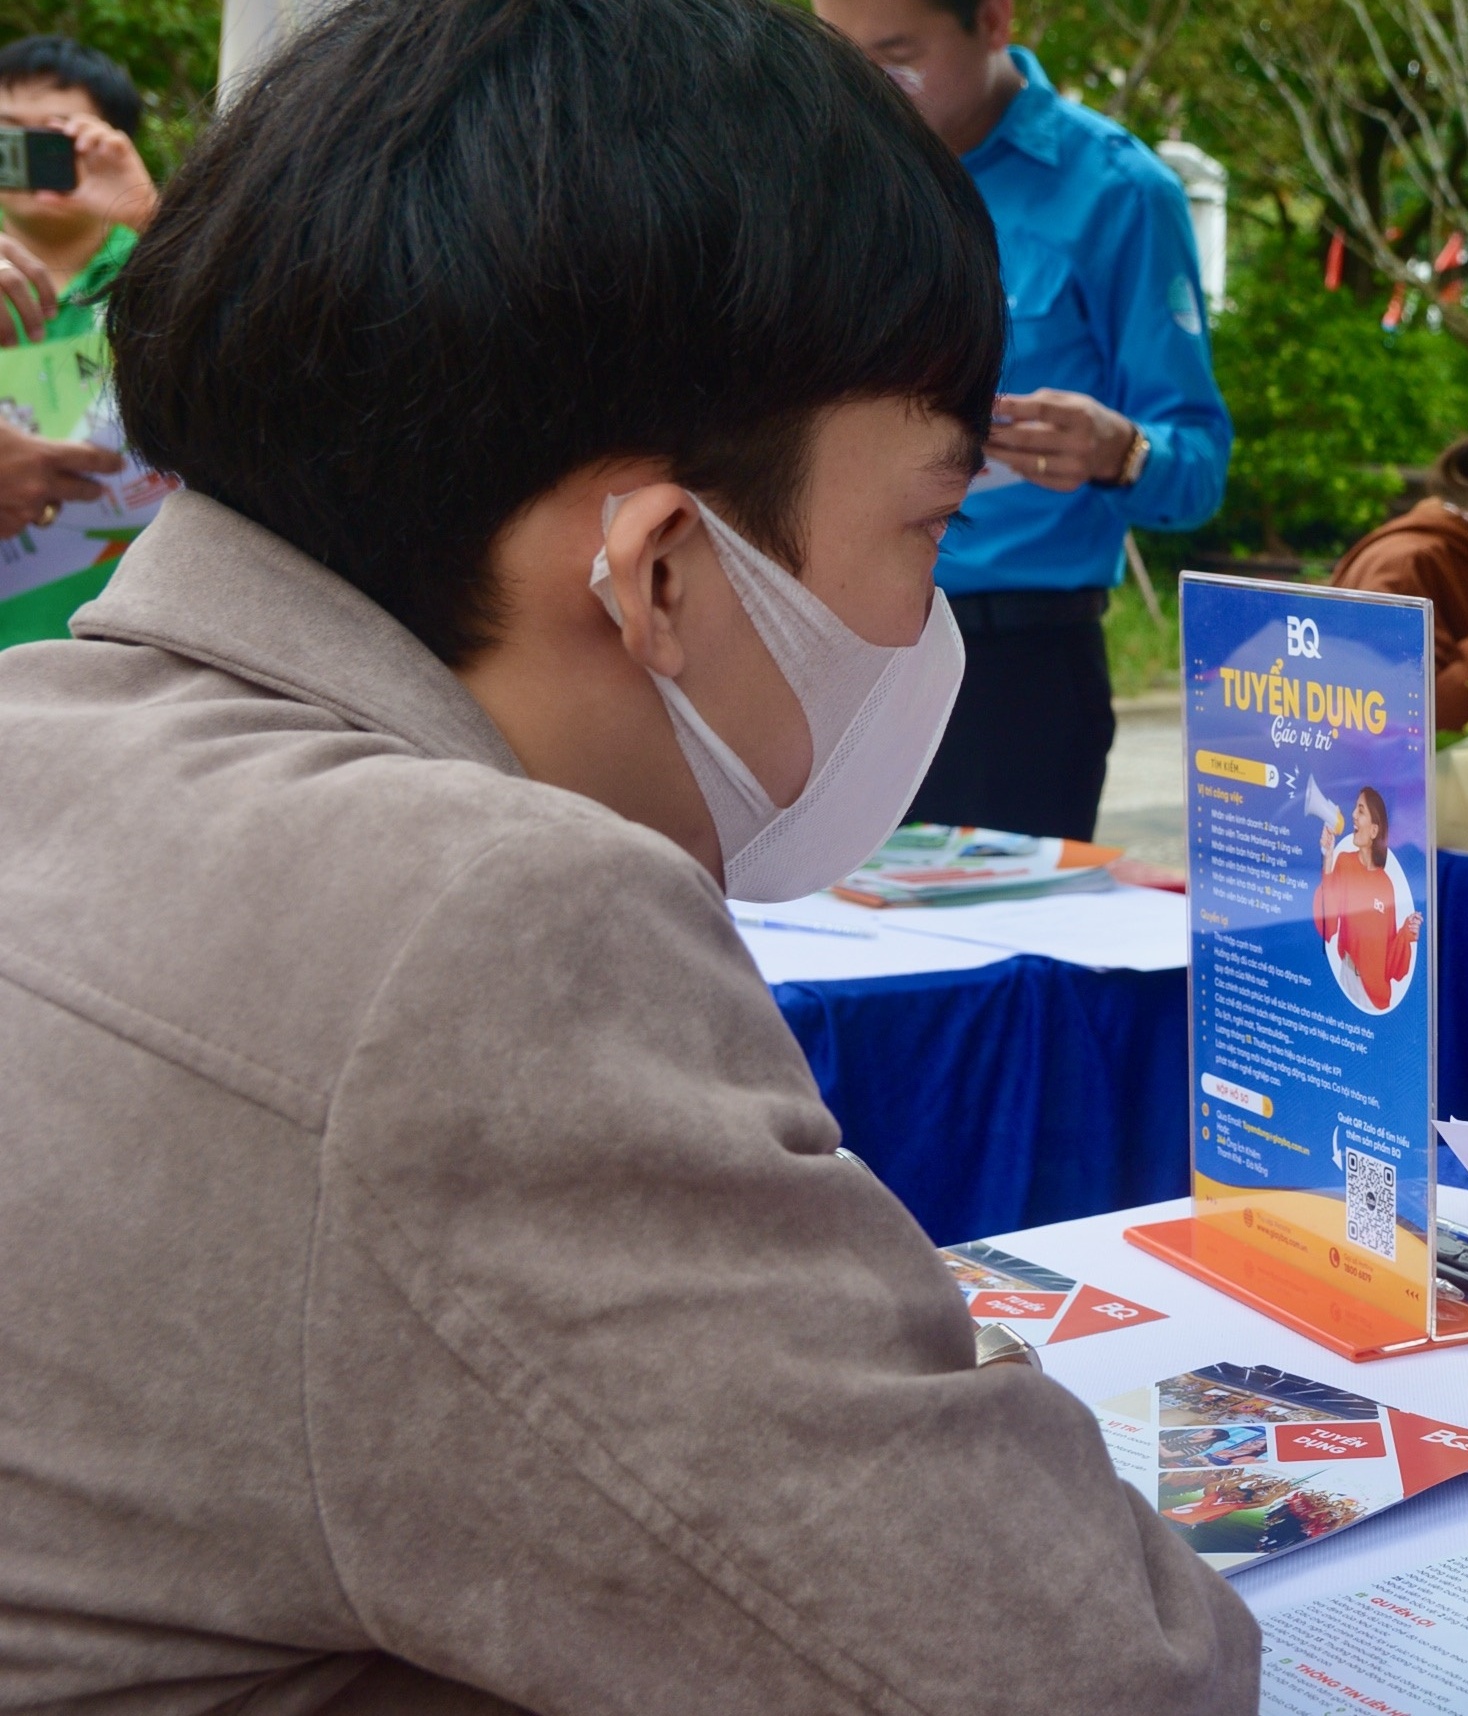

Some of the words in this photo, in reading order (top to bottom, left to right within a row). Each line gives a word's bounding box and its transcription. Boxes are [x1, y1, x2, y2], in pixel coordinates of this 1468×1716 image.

[1286, 615, 1322, 659] BQ
[1220, 658, 1300, 719] TUYỂN
[1306, 680, 1387, 739] DỤNG
[1271, 715, 1297, 748] Các
[1300, 726, 1314, 751] vị
[1316, 728, 1333, 751] trí
[1210, 757, 1221, 770] TÌM
[1373, 898, 1385, 914] BQ
[1354, 1116, 1362, 1129] QR
[1364, 1120, 1376, 1135] Zalo
[1392, 1145, 1401, 1160] BQ
[1344, 1262, 1357, 1278] 1800
[985, 1300, 1025, 1316] DỤNG
[1004, 1295, 1046, 1312] TUYỂN
[1091, 1302, 1139, 1321] BQ
[1293, 1436, 1347, 1454] DỤNG
[1310, 1428, 1369, 1449] TUYỂN
[1370, 1597, 1414, 1618] QUYỀN
[1411, 1614, 1437, 1628] LỢI
[1295, 1663, 1341, 1688] THÔNG
[1339, 1685, 1364, 1699] TIN
[1358, 1696, 1391, 1713] LIÊN
